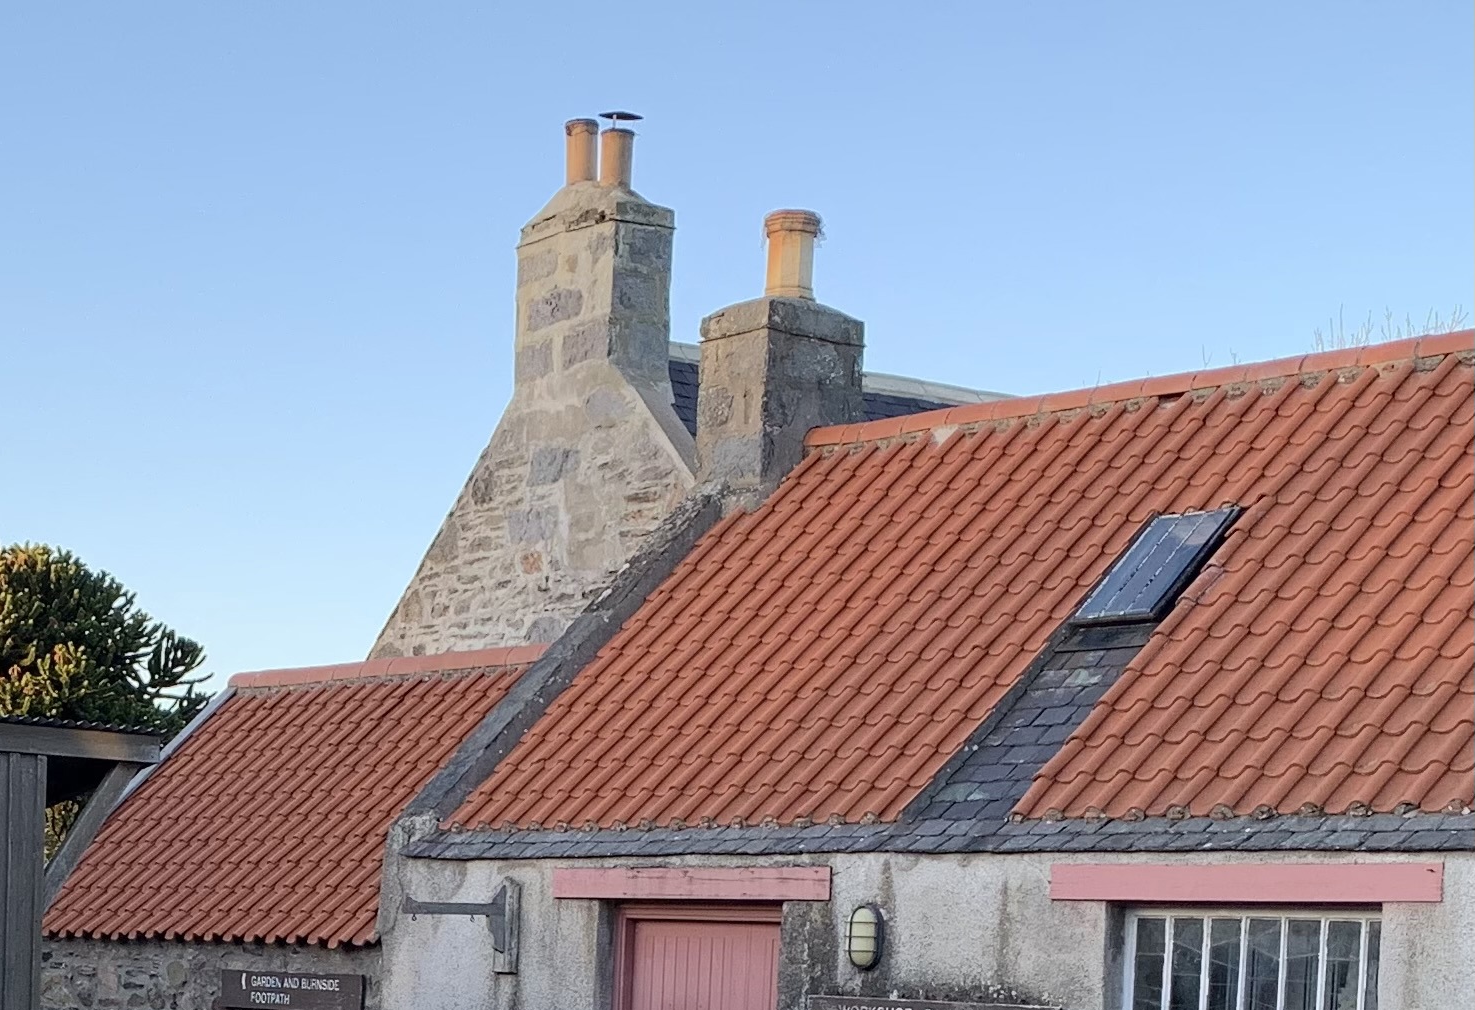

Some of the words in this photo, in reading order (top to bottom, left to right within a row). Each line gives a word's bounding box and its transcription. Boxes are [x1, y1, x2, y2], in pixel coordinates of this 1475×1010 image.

[250, 975, 281, 989] GARDEN
[283, 976, 300, 989] AND
[301, 977, 340, 991] BURNSIDE
[250, 992, 290, 1005] FOOTPATH
